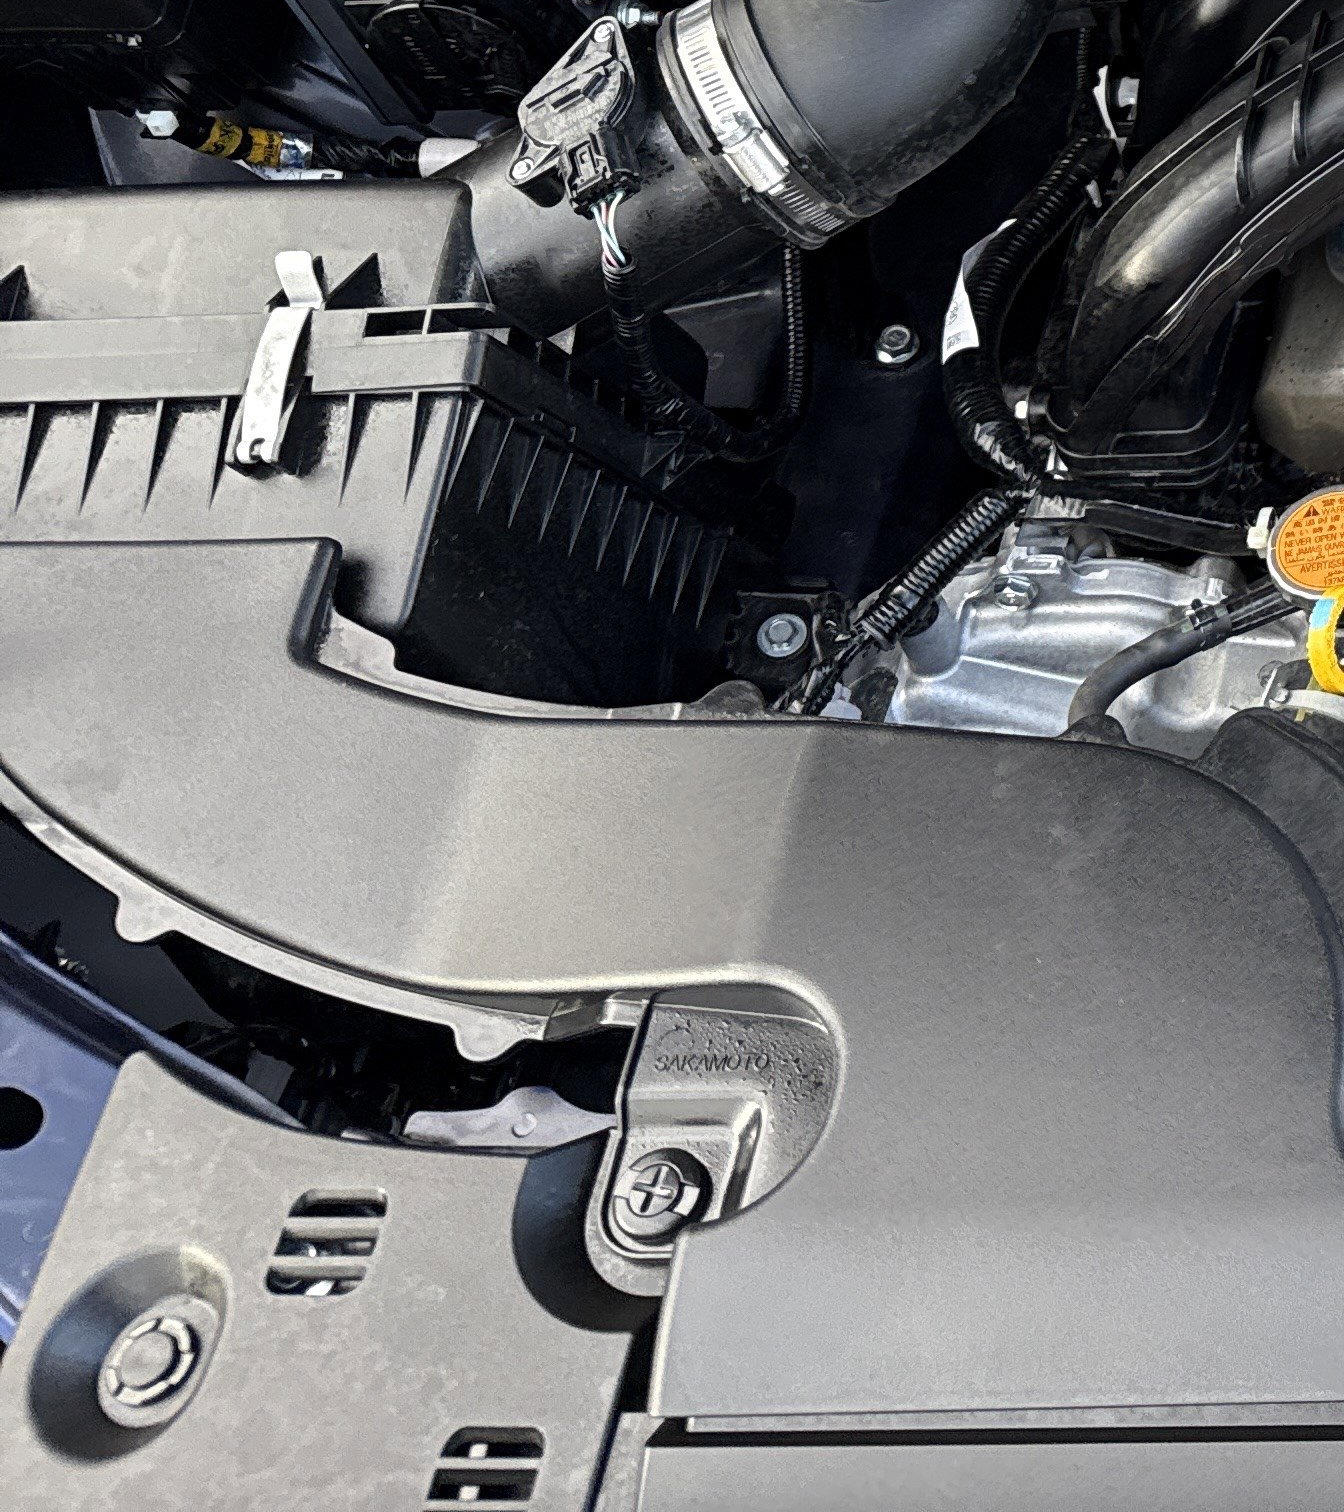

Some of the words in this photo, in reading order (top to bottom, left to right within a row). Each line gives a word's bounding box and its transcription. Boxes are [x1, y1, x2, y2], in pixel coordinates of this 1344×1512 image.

[1284, 536, 1312, 548] NEVER
[1314, 533, 1337, 544] OPEN
[1284, 549, 1294, 558] NE
[654, 1051, 770, 1072] SAKAMOTO
